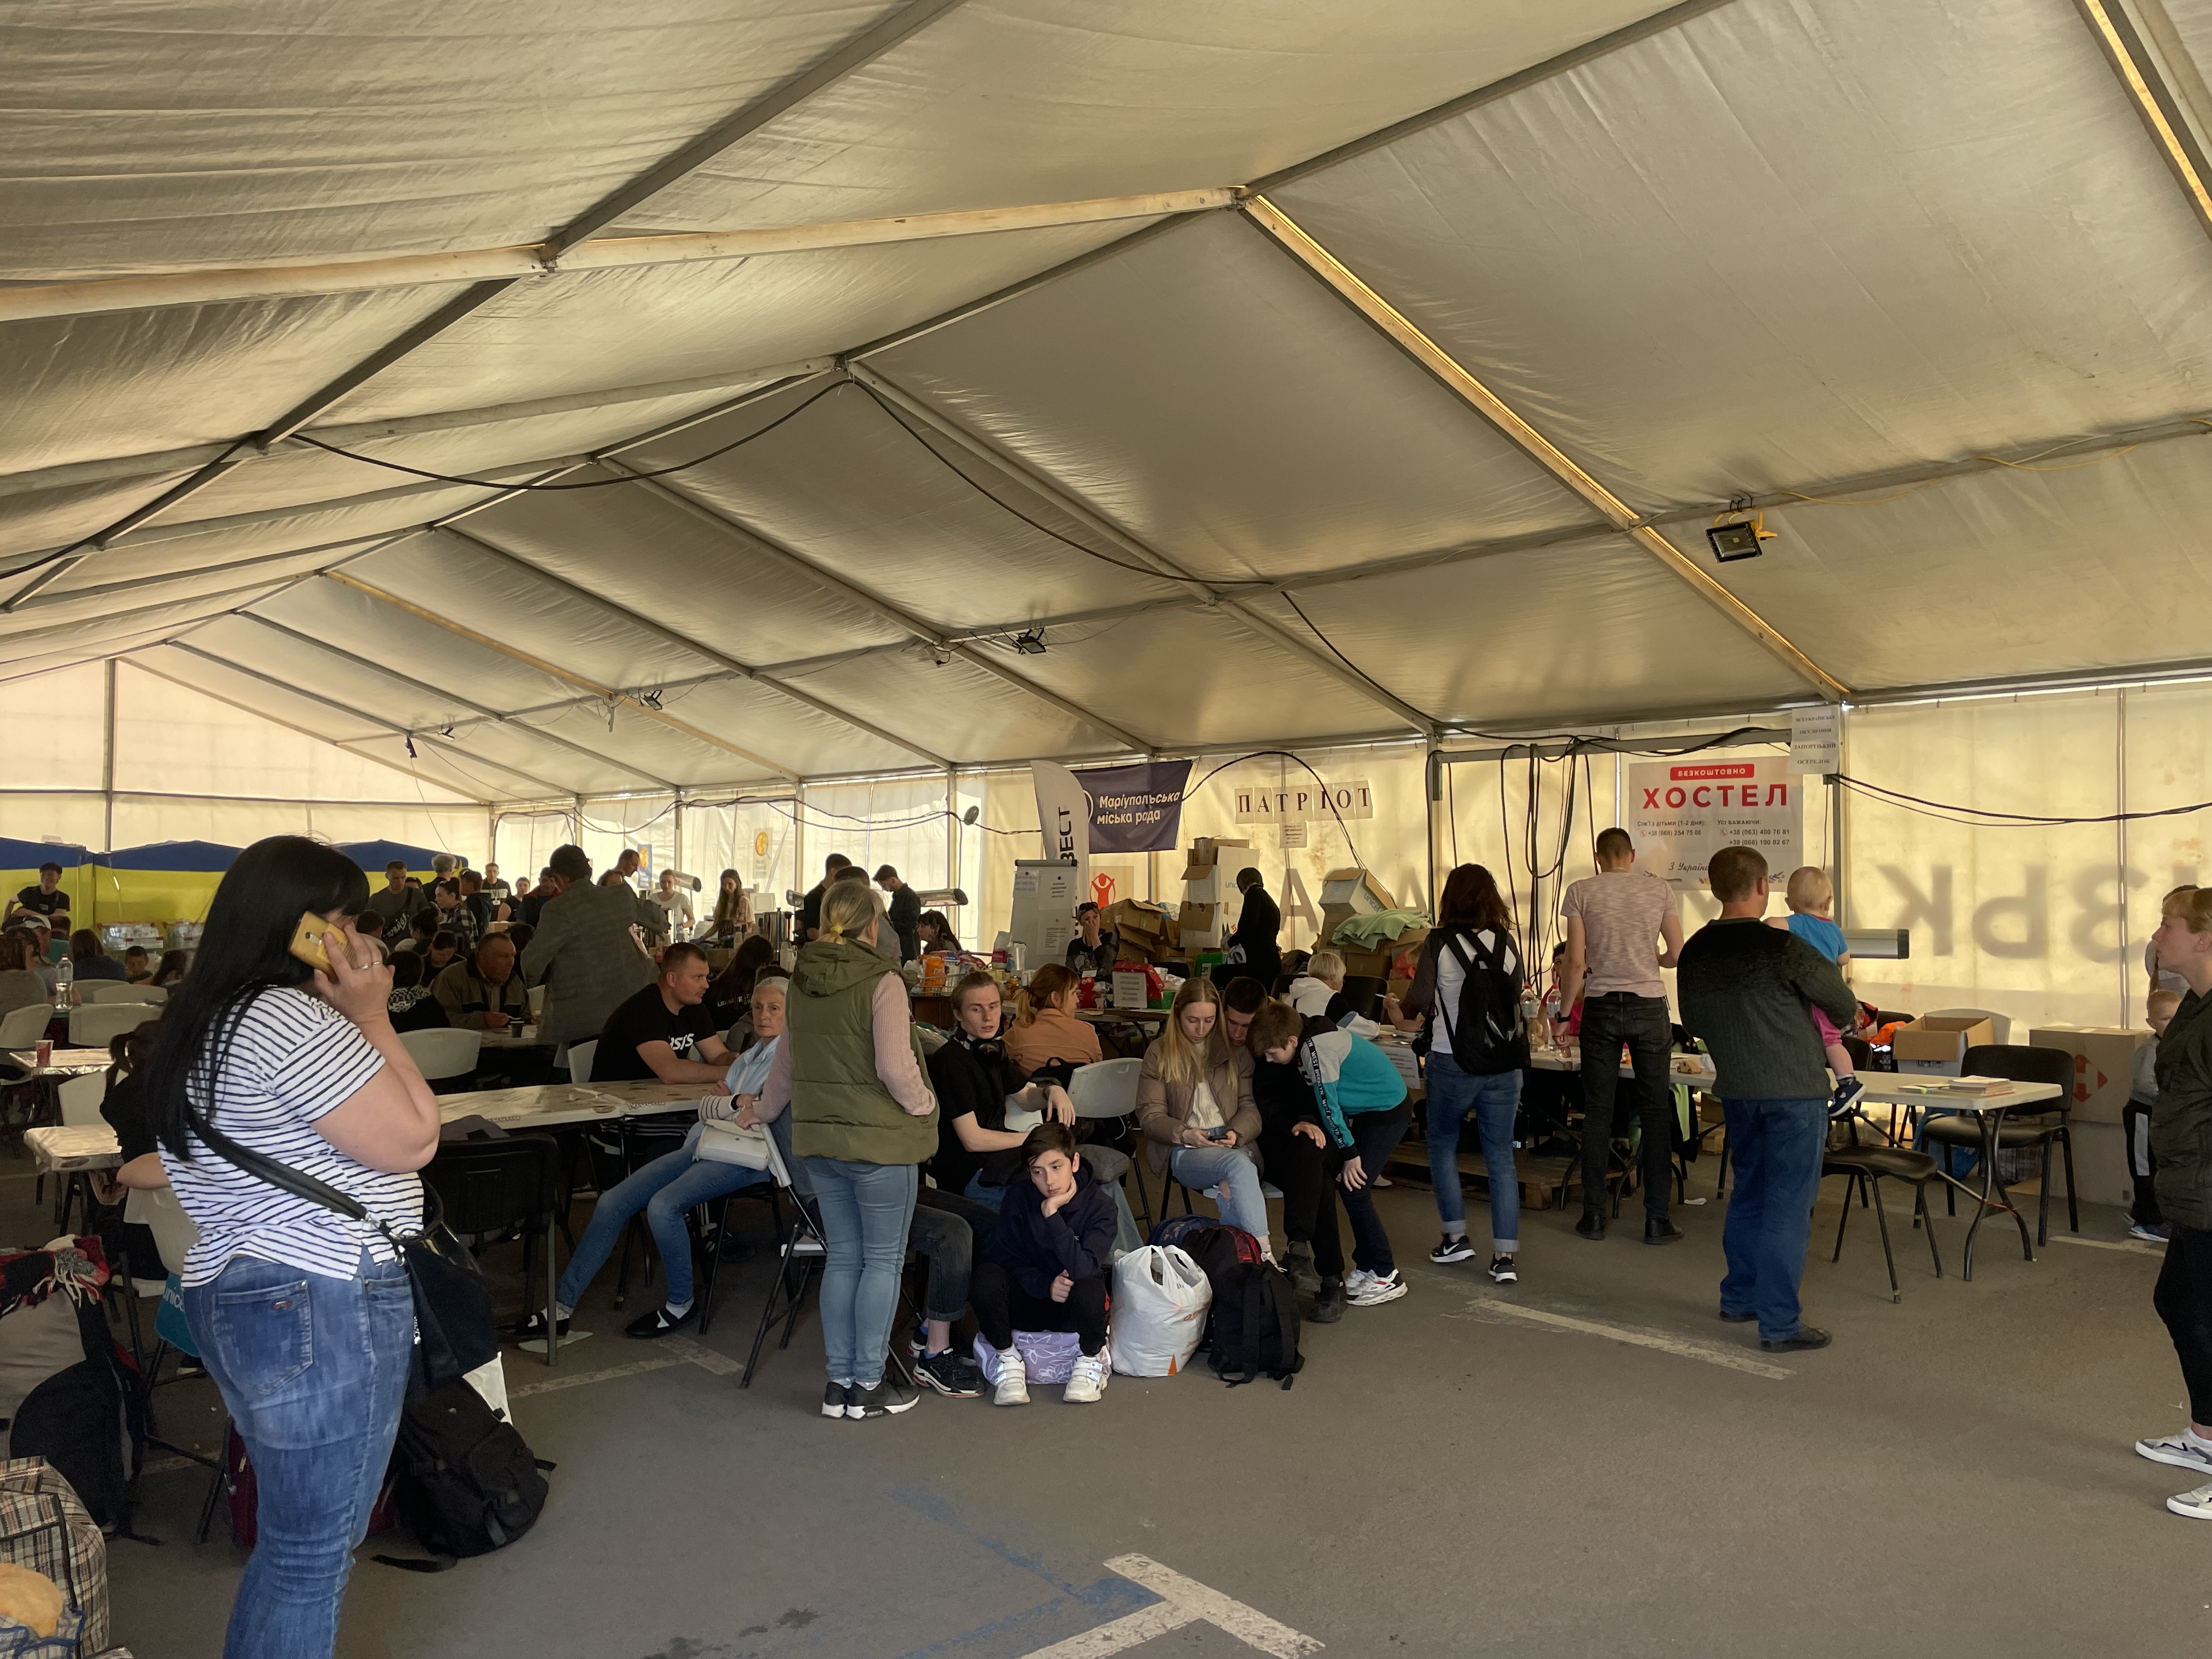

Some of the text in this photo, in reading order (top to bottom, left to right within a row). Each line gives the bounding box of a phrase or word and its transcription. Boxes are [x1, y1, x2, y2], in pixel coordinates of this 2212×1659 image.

[1678, 768, 1746, 777] БЕЗКОШТОВНО
[1099, 791, 1181, 811] Маріупольська
[1237, 787, 1369, 813] ПАТРІОТ
[1643, 784, 1787, 809] ХОСТЕЛ
[1097, 809, 1161, 825] міська рада
[1364, 893, 1381, 913] unicef
[488, 1115, 521, 1123] ocha
